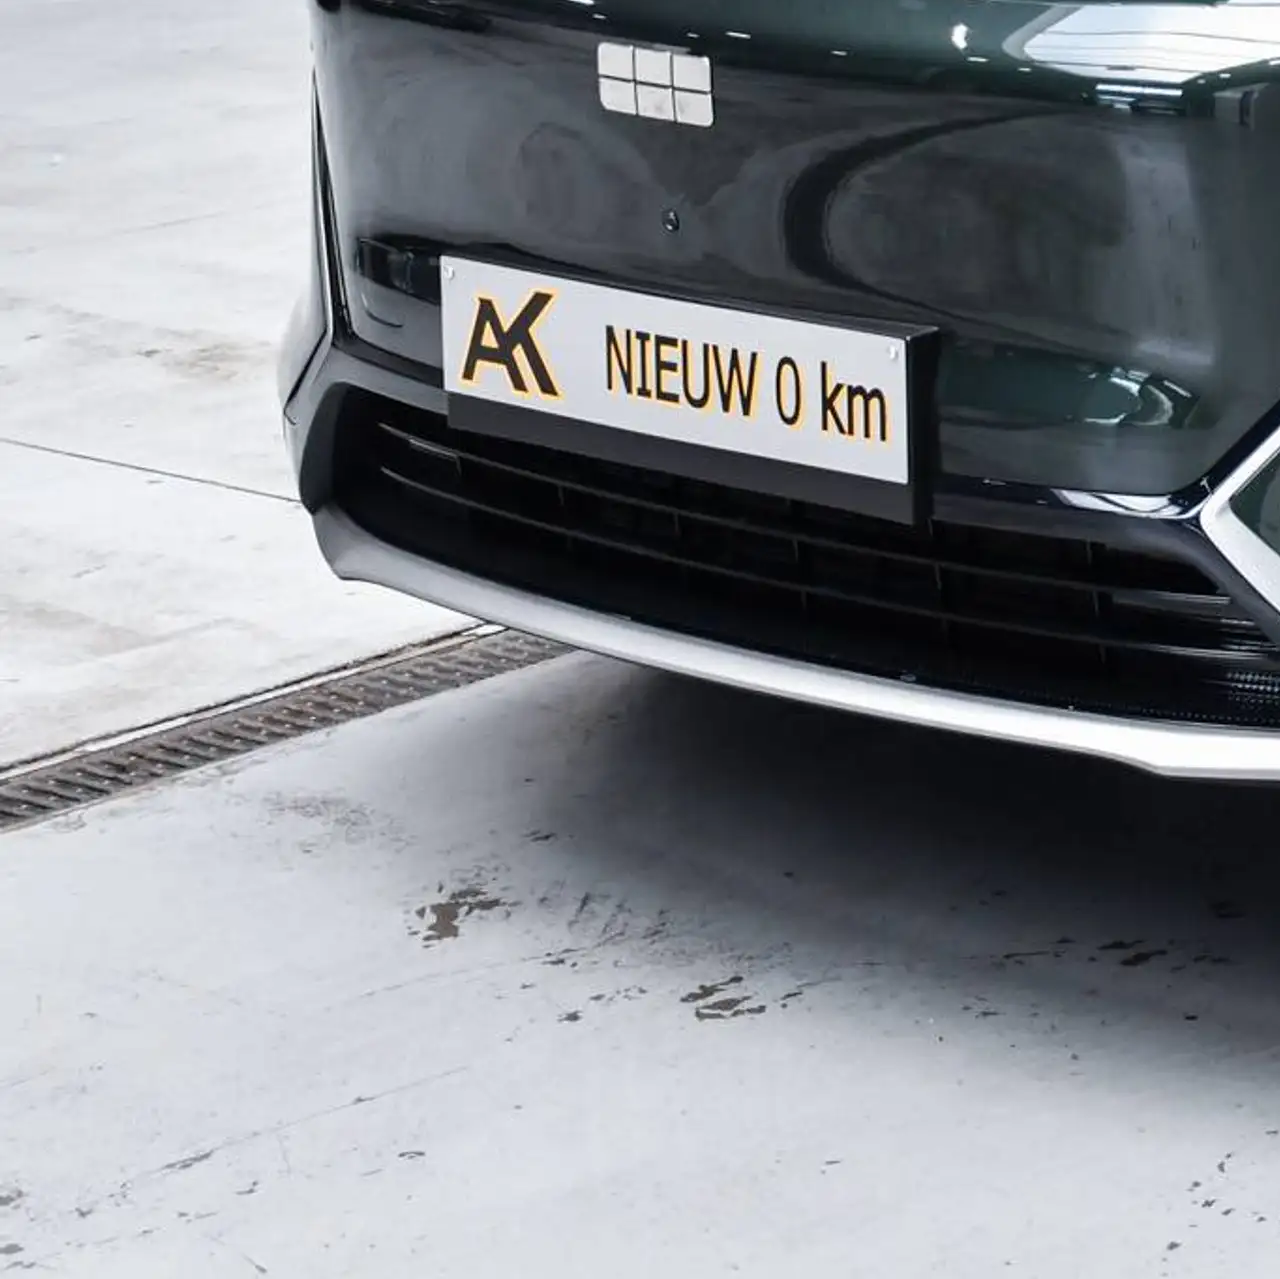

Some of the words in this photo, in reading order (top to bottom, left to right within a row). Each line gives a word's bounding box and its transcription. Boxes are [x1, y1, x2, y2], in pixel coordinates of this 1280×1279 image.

[460, 289, 561, 399] AK
[605, 325, 758, 417] NIEUW
[775, 356, 802, 426] 0
[821, 361, 888, 441] km
